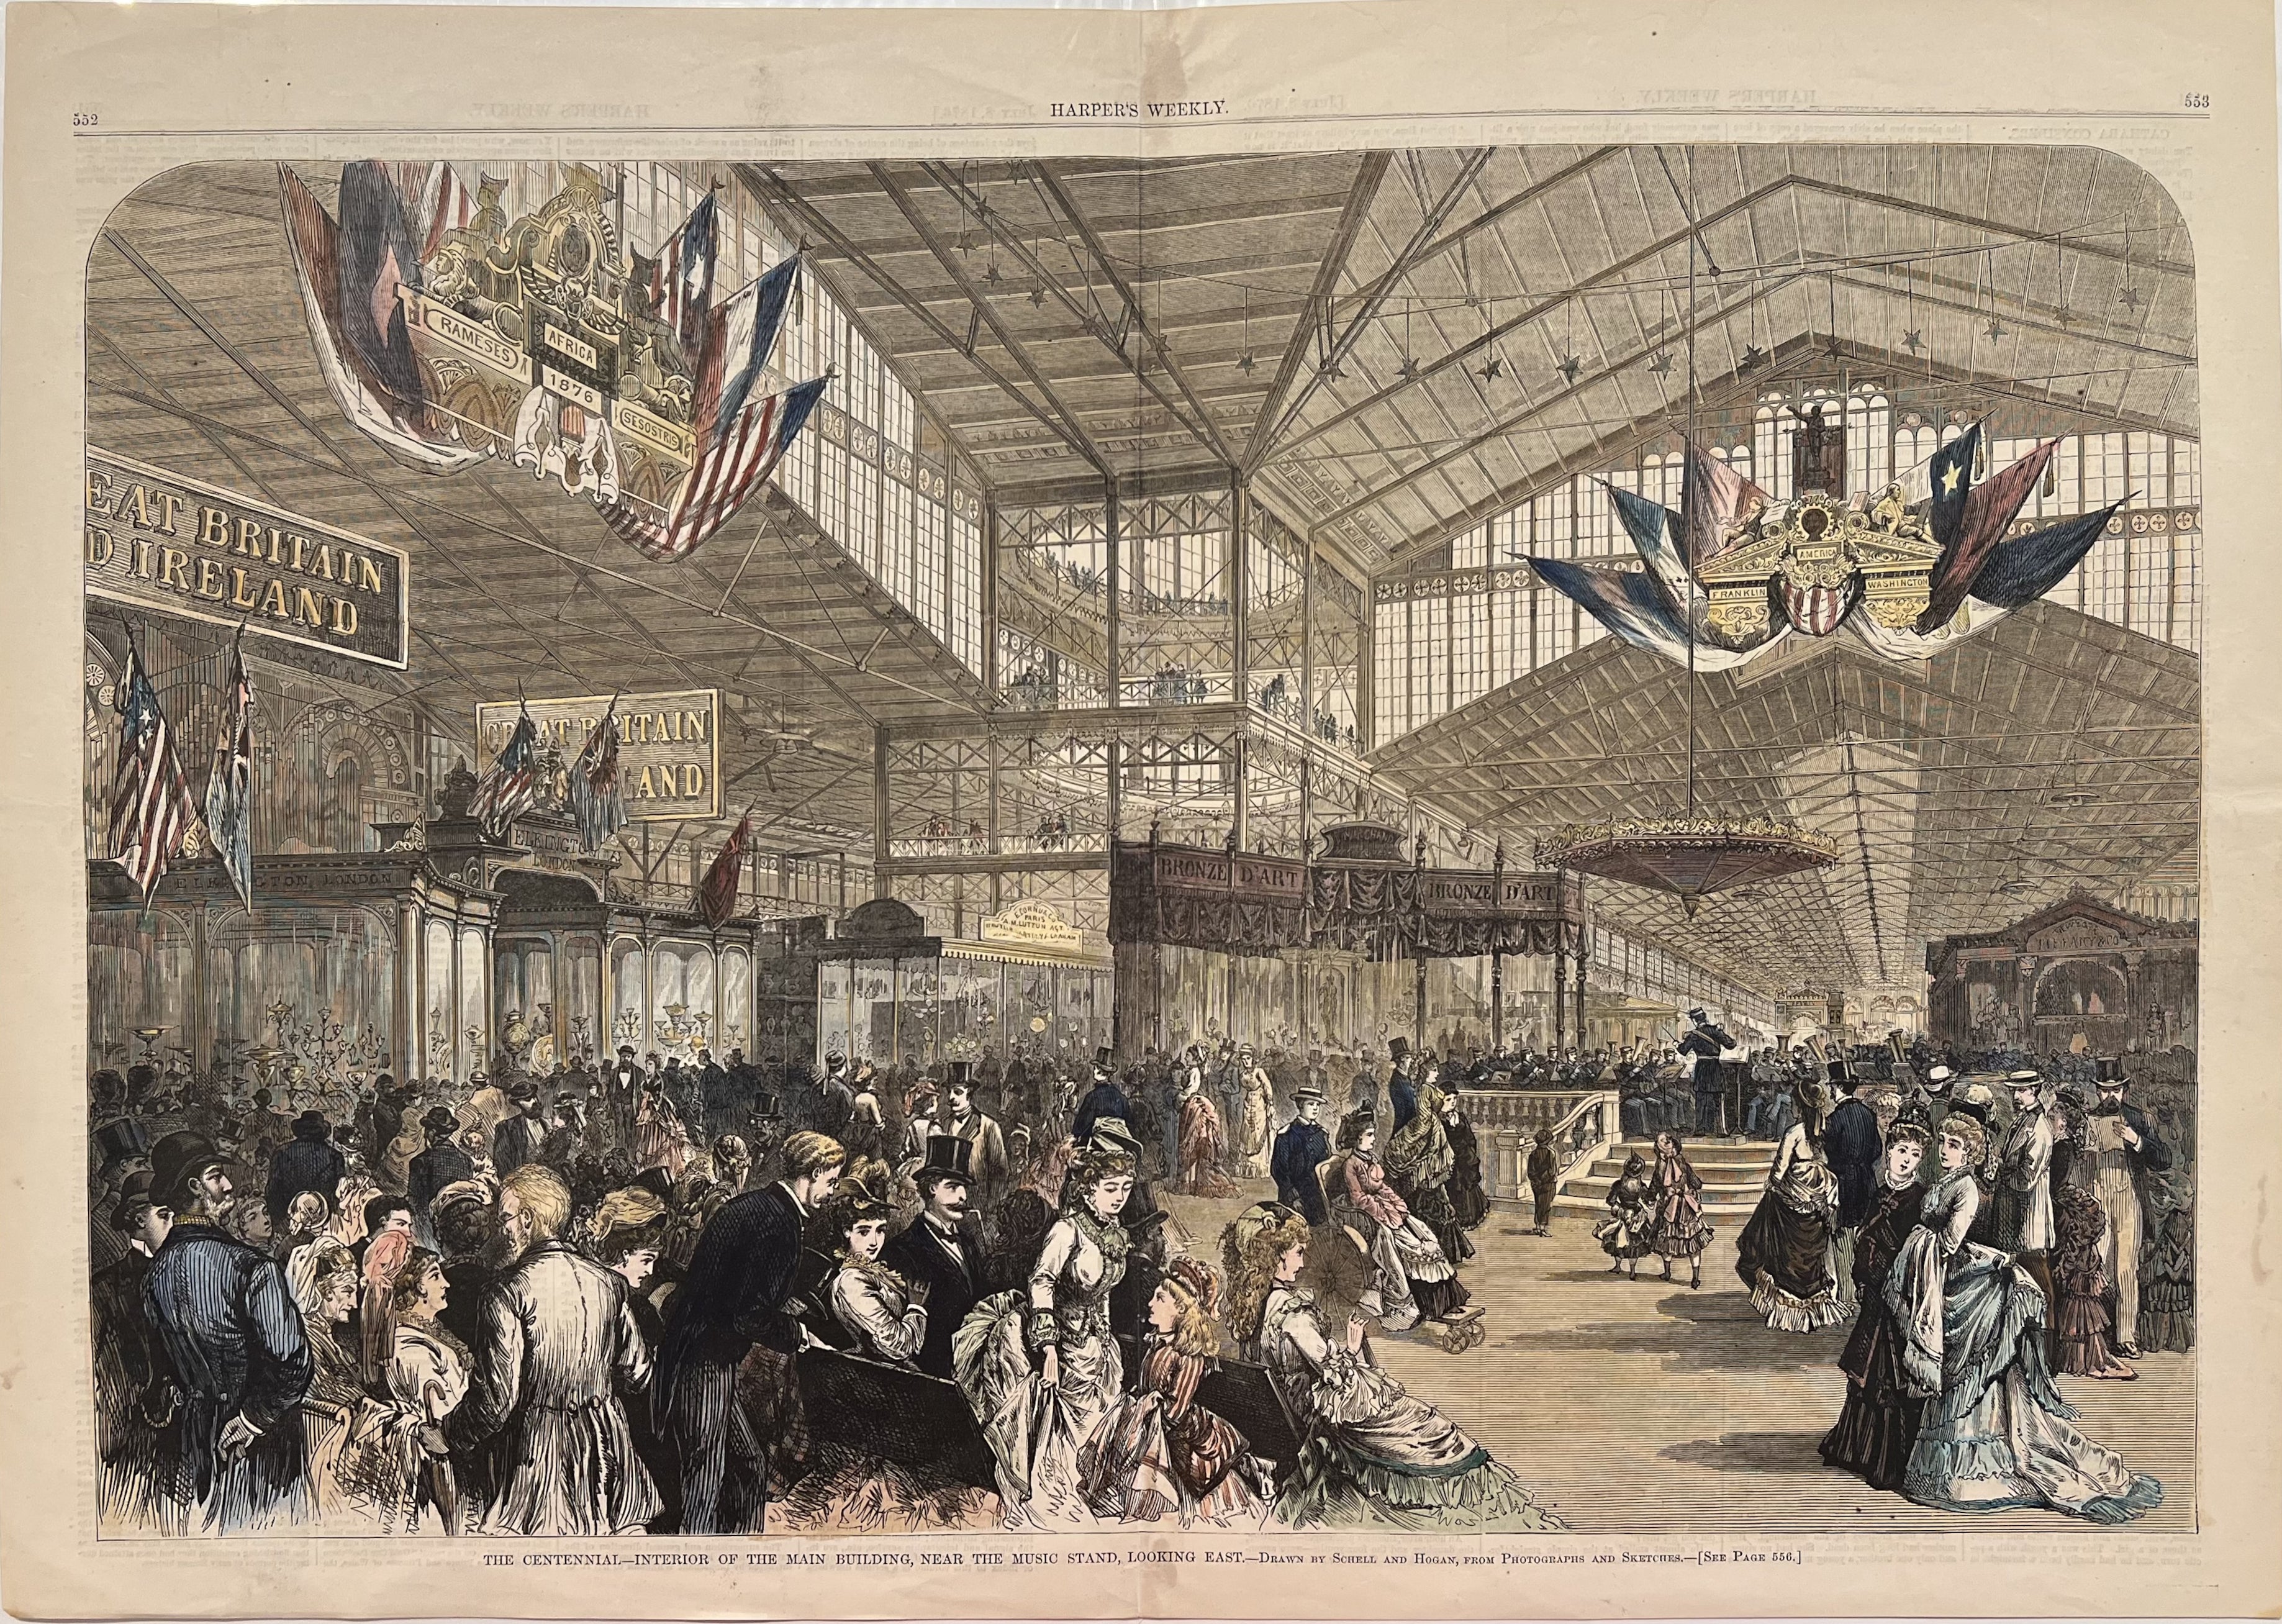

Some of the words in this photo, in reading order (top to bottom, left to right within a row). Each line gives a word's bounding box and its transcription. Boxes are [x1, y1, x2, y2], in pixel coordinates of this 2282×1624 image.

[1050, 101, 1139, 117] HARPER'S
[1147, 99, 1229, 117] WEEKLY.
[2185, 92, 2209, 108] 553
[73, 112, 98, 126] 552
[441, 315, 510, 361] RAMESES
[548, 331, 594, 365] AFRICA
[550, 373, 594, 404] 1876
[623, 412, 679, 453] SESOSTRIS
[196, 506, 384, 596] BRITAIN
[1800, 548, 1836, 559] AMERICA
[125, 537, 360, 637] IRELAND
[1867, 578, 1929, 589] WASHINGTON
[1713, 587, 1766, 599] FRANKLIN
[484, 718, 573, 754] GRAT
[579, 710, 708, 745] BITAIN
[323, 872, 392, 886] LONDON
[1161, 858, 1228, 881] BRONZE
[1240, 865, 1298, 887] D'ART
[1429, 882, 1491, 900] BRONZE
[1505, 883, 1557, 901] D'ART
[1025, 915, 1046, 923] PARIS
[483, 1554, 514, 1566] THE
[718, 1554, 738, 1565] OF
[747, 1554, 777, 1565] THE
[786, 1553, 825, 1564] MAIN
[835, 1553, 913, 1567] BUILDING,
[920, 1553, 963, 1564] NEAR
[972, 1553, 1003, 1564] THE
[1012, 1553, 1058, 1564] MUSIC
[1067, 1552, 1121, 1566] STAND,
[1128, 1551, 1196, 1563] LOOKING
